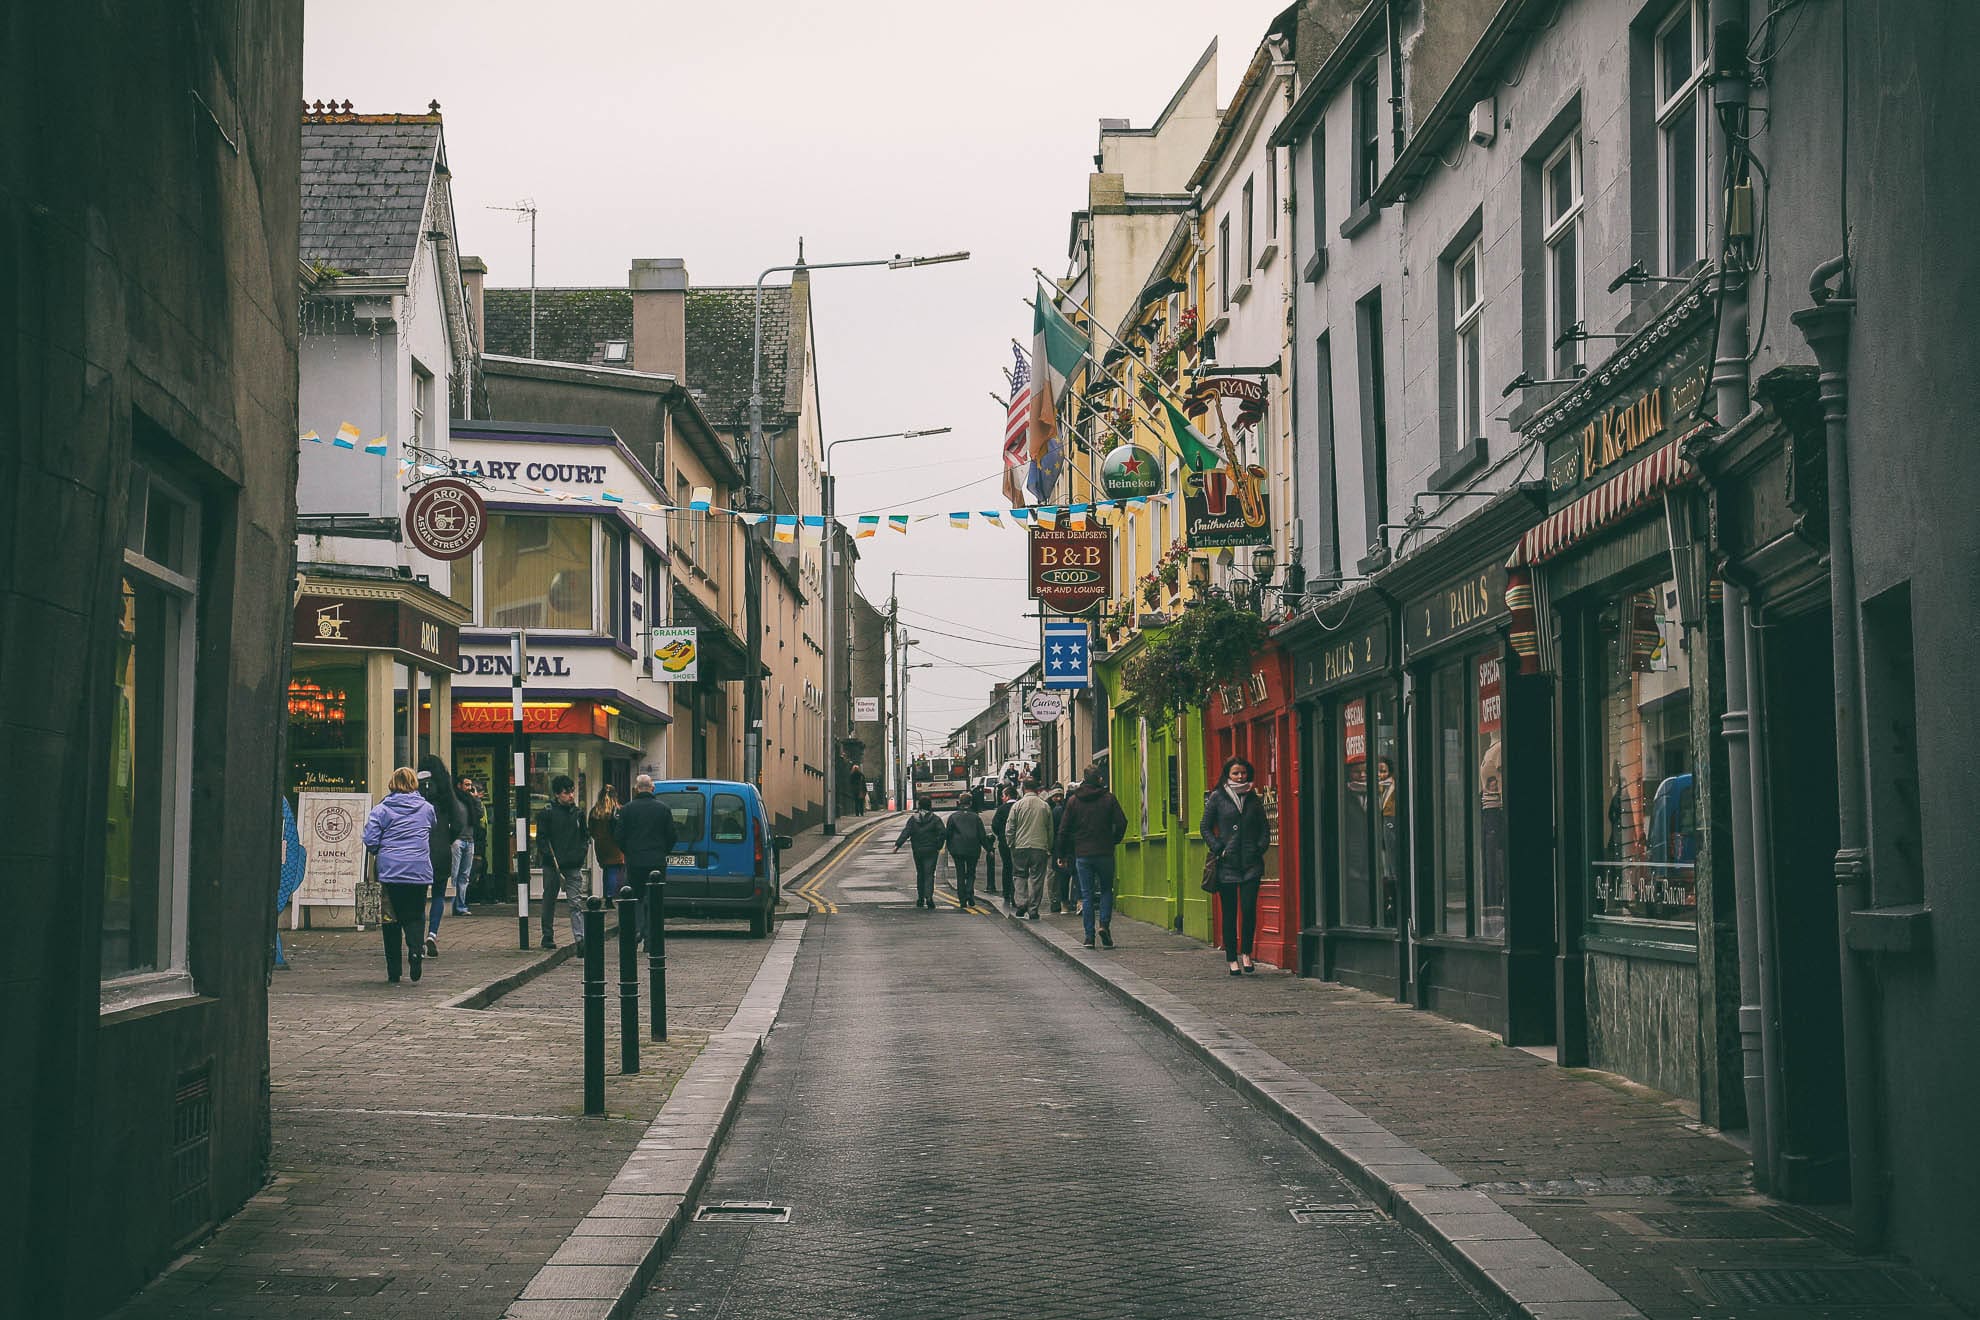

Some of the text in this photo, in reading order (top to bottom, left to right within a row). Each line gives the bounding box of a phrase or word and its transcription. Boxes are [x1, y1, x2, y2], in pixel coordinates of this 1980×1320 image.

[1219, 380, 1263, 400] RYANS
[1601, 385, 1664, 468] Kenna
[447, 458, 607, 484] RIARY COURT
[1108, 479, 1156, 489] Heineken
[432, 490, 464, 502] AROI
[416, 514, 477, 549] ASIAN STREET FOOD
[1034, 531, 1108, 539] RAFTER DEMPSEYS
[1190, 517, 1247, 535] Smithwick's
[1040, 546, 1101, 566] B & B
[1054, 571, 1088, 582] FOOD
[1036, 586, 1105, 594] BAR AND LOUNGE
[1424, 575, 1489, 637] 2 PAULS
[421, 621, 440, 655] AROI
[653, 629, 696, 637] GRAHAMS
[1324, 641, 1355, 682] PAULS
[1365, 636, 1372, 662] 2
[1479, 658, 1501, 688] SPECIA
[1031, 697, 1061, 708] Curves
[1482, 695, 1501, 724] OFFER
[1344, 703, 1365, 728] SPECIAL
[1345, 734, 1365, 757] OFFERS
